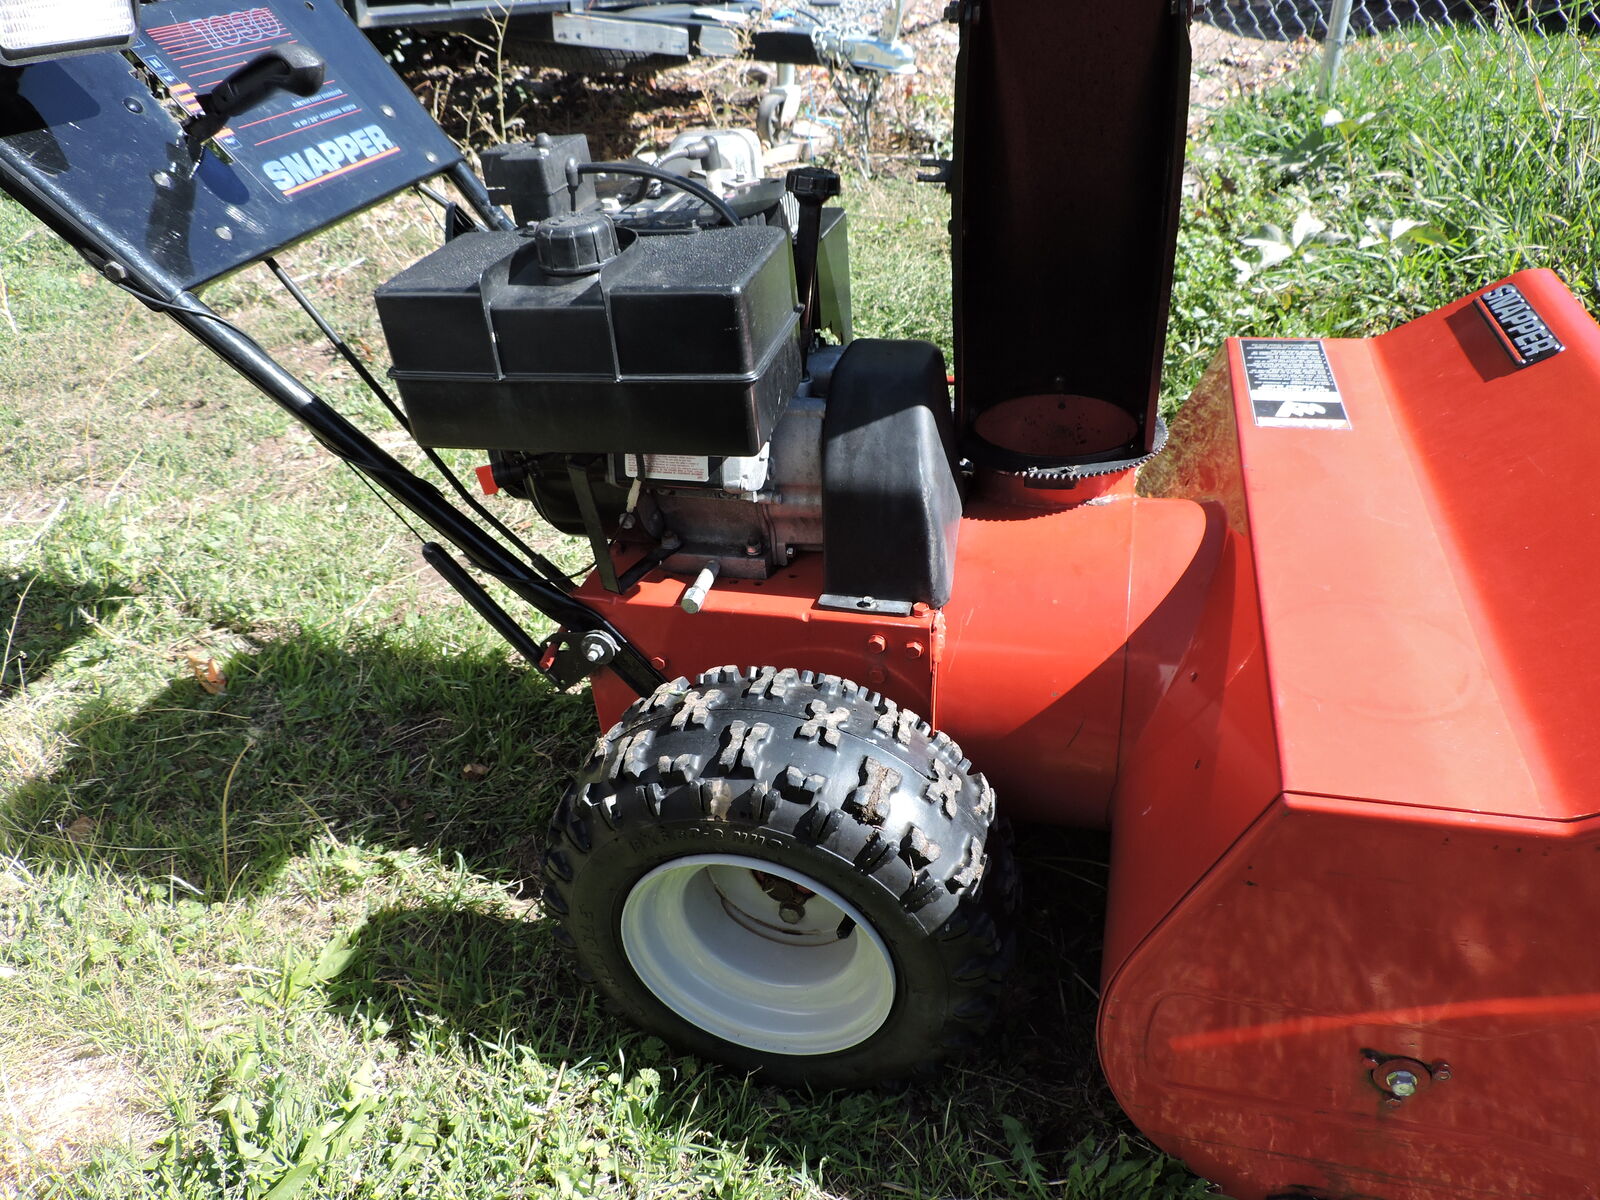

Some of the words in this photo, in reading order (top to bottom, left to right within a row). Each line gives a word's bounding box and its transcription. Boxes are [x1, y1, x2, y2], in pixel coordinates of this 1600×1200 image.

[188, 8, 282, 49] 1030
[262, 124, 394, 191] SNAPPER
[1482, 283, 1554, 357] SNAPPER
